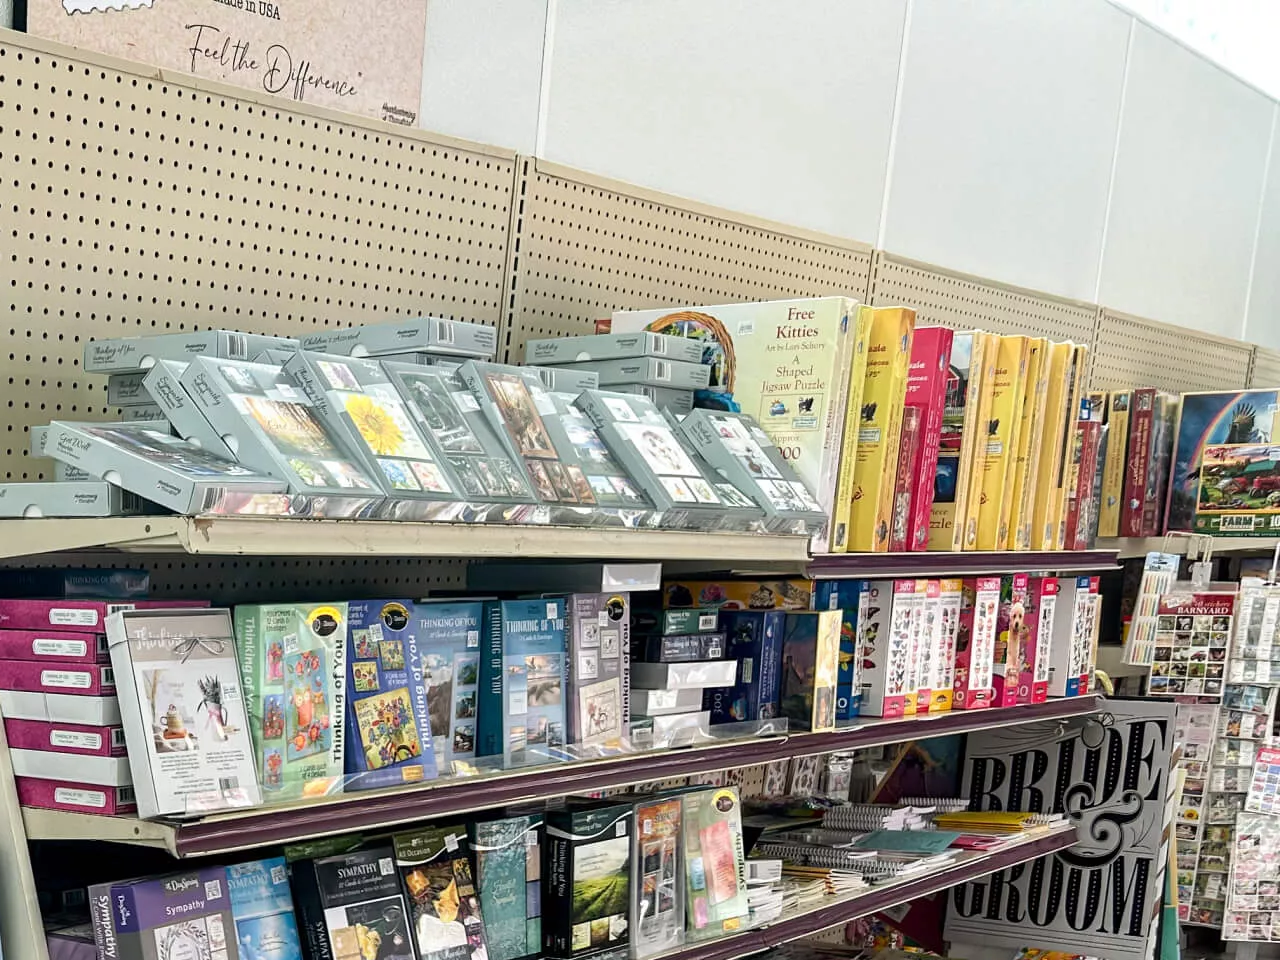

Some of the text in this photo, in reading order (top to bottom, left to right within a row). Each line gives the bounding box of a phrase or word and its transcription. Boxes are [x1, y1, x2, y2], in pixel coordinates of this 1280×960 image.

[245, 0, 256, 13] in
[259, 1, 280, 20] USA
[233, 39, 259, 71] the
[788, 308, 815, 321] Free
[776, 325, 819, 339] Kitties
[792, 356, 799, 364] A
[776, 365, 813, 379] Shaped
[761, 379, 825, 393] Jigsaw Puzzle
[1223, 516, 1253, 526] FARM
[420, 618, 450, 629] THINKING
[460, 618, 477, 628] YOU
[505, 619, 564, 633] THINKING OF YOU
[331, 638, 345, 764] Thinking of You
[968, 717, 1170, 816] BRIDE
[337, 862, 377, 879] SYMPATHY
[165, 899, 205, 917] Sympathy
[99, 895, 117, 959] Sympathy
